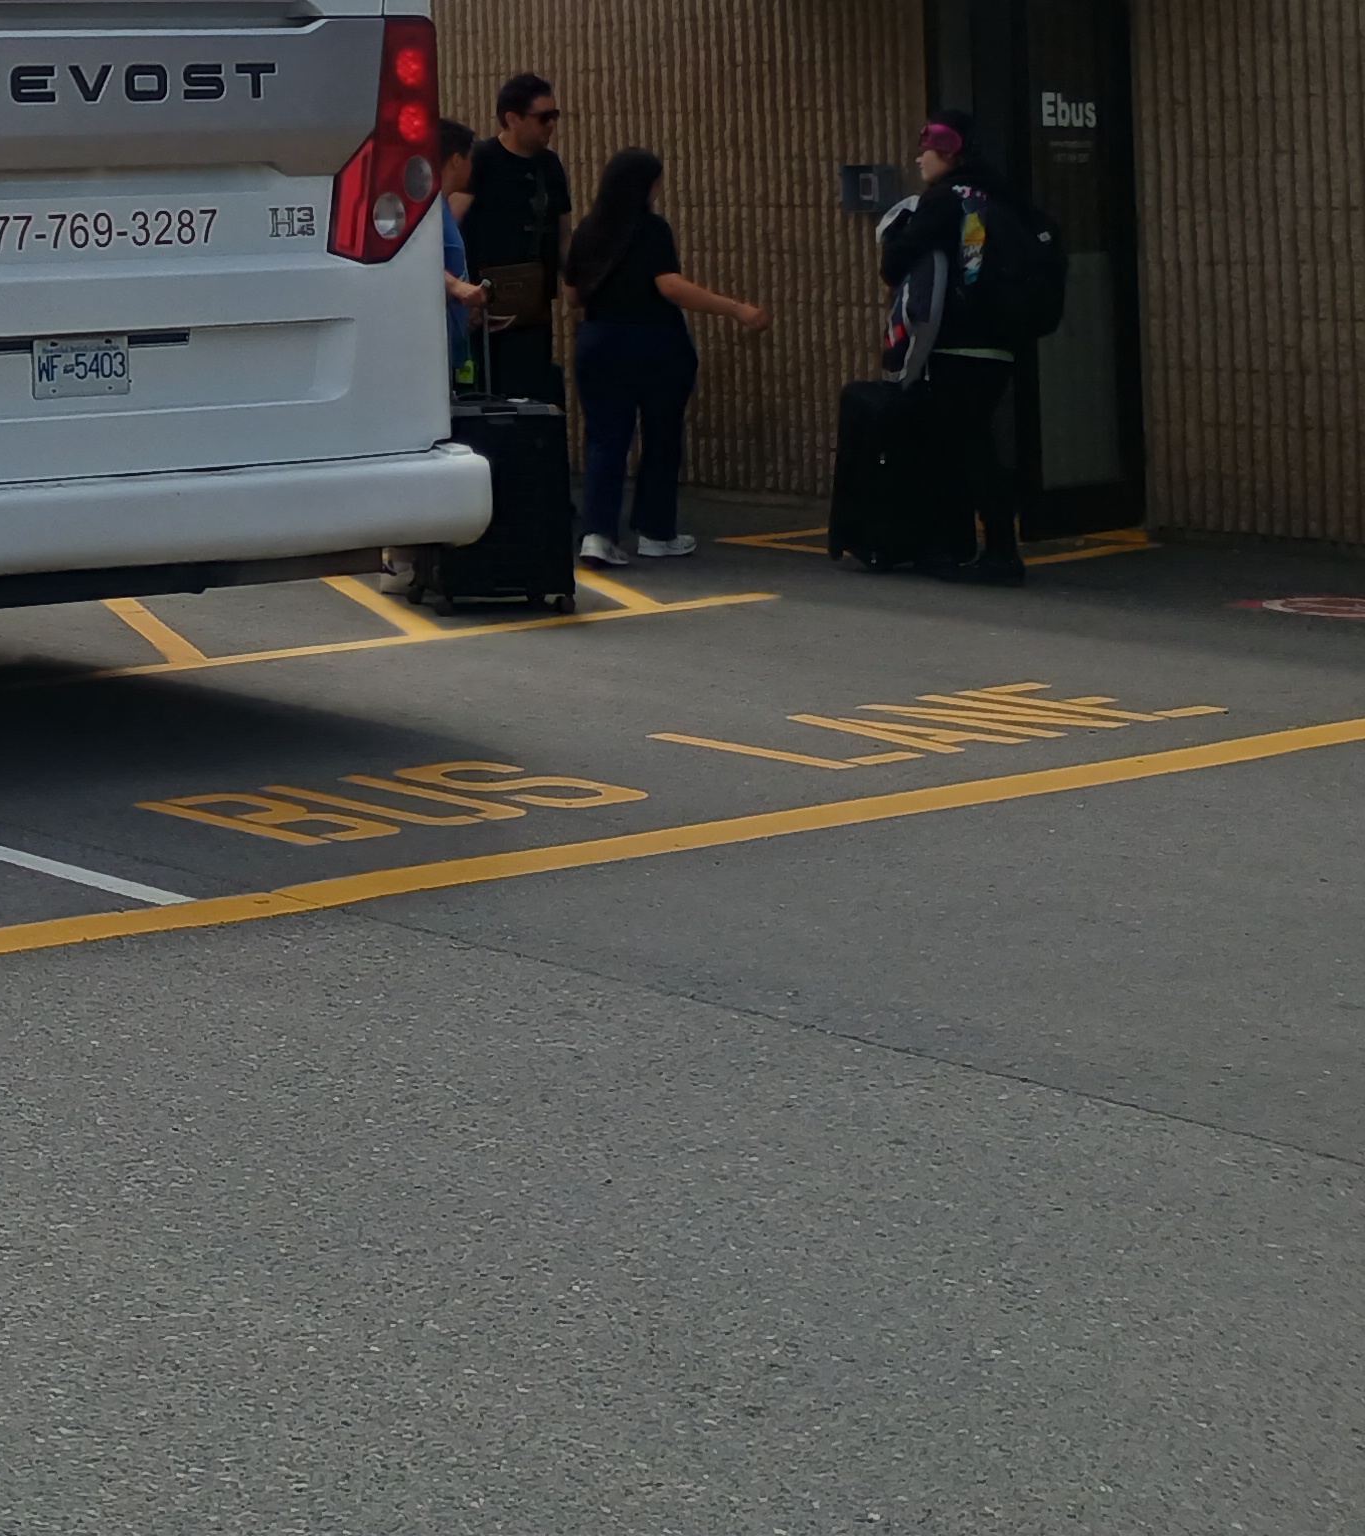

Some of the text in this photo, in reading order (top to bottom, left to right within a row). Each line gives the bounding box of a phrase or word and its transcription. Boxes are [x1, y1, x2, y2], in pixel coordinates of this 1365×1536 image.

[1042, 92, 1097, 128] Ebus
[38, 352, 126, 382] WF 5403
[134, 681, 1230, 847] BUS LANE
